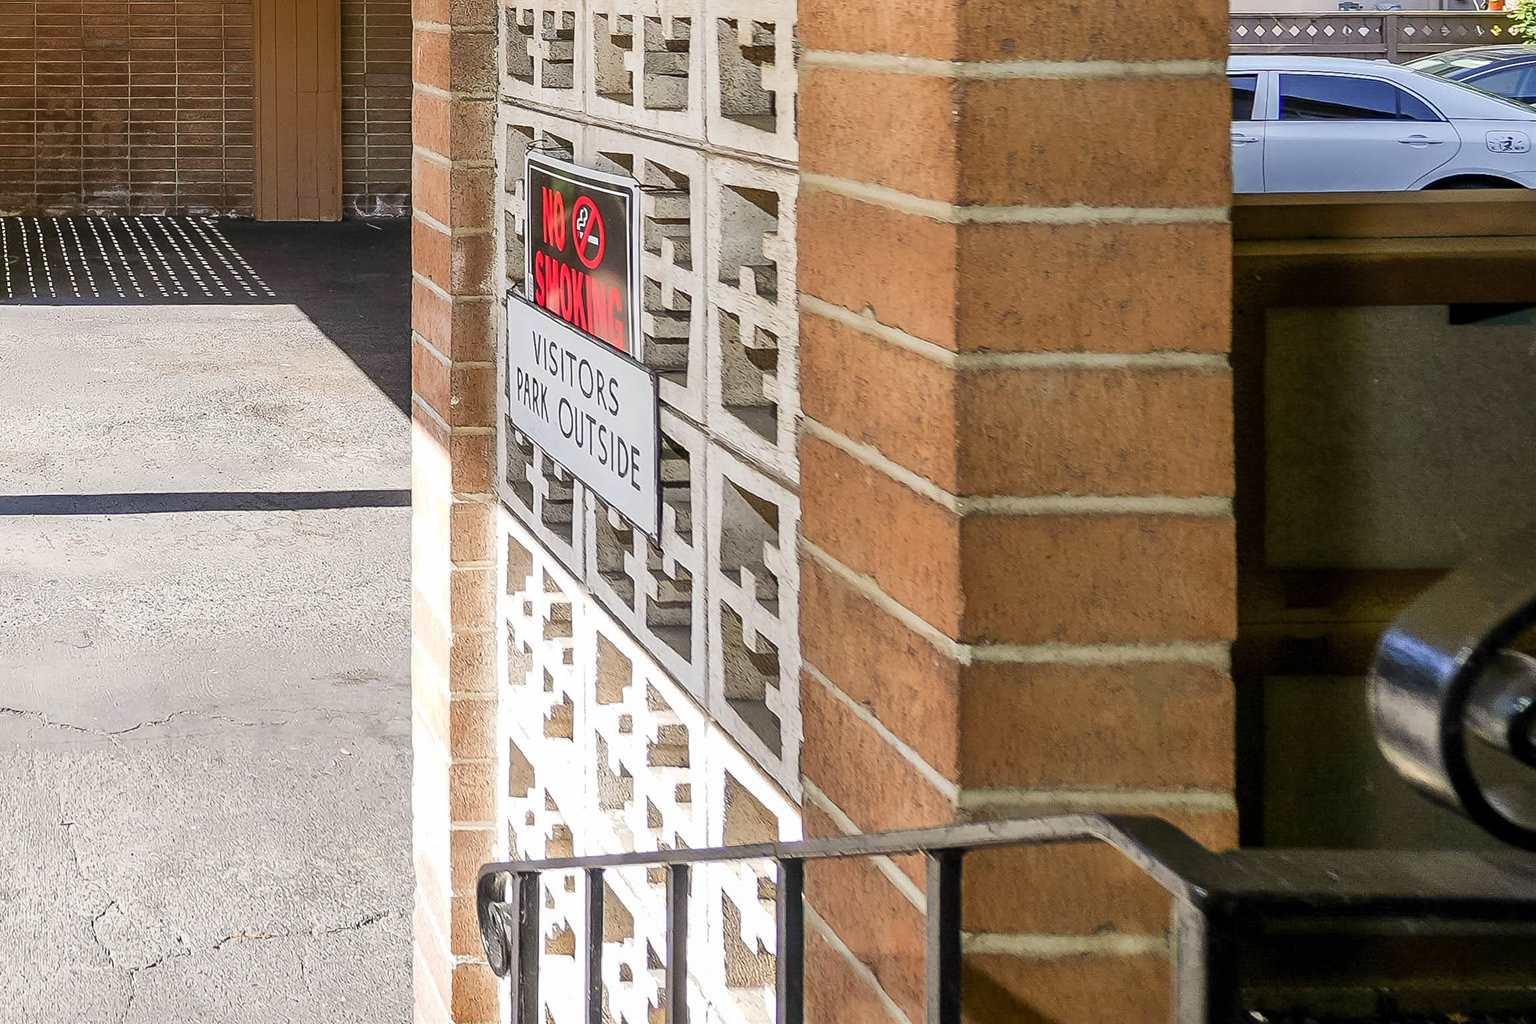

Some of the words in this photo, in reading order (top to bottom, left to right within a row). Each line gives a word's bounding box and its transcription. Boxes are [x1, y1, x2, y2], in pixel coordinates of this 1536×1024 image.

[541, 186, 567, 252] NO
[535, 250, 625, 352] SMOKING
[532, 330, 619, 416] VISITORS
[517, 367, 549, 423] PARK
[558, 397, 641, 491] OUTSIDE
